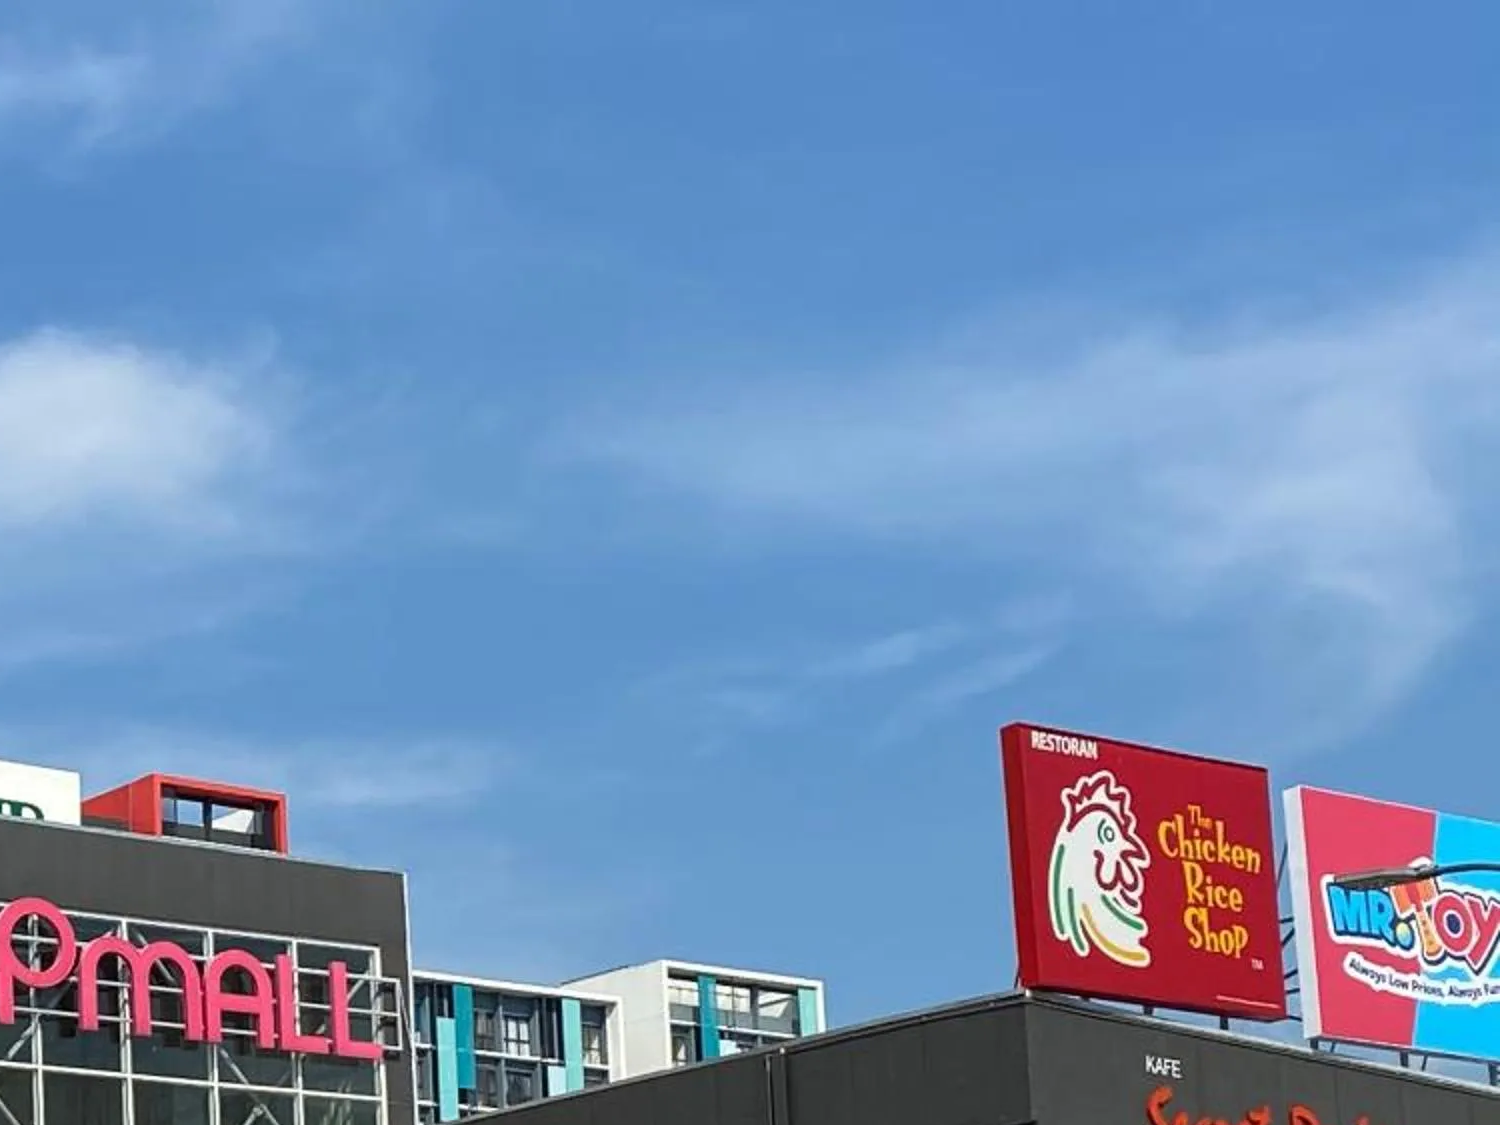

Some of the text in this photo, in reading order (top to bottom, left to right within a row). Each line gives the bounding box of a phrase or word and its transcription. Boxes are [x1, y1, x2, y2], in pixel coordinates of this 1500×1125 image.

[1031, 730, 1098, 759] RESTORAN
[1187, 804, 1213, 828] The
[1158, 813, 1261, 874] Chicken
[1182, 861, 1243, 912] Rice
[1183, 905, 1249, 959] Shop
[1349, 957, 1388, 985] Always
[1388, 974, 1409, 990] Low
[1449, 984, 1483, 1001] Always
[1145, 1054, 1183, 1079] KAFE
